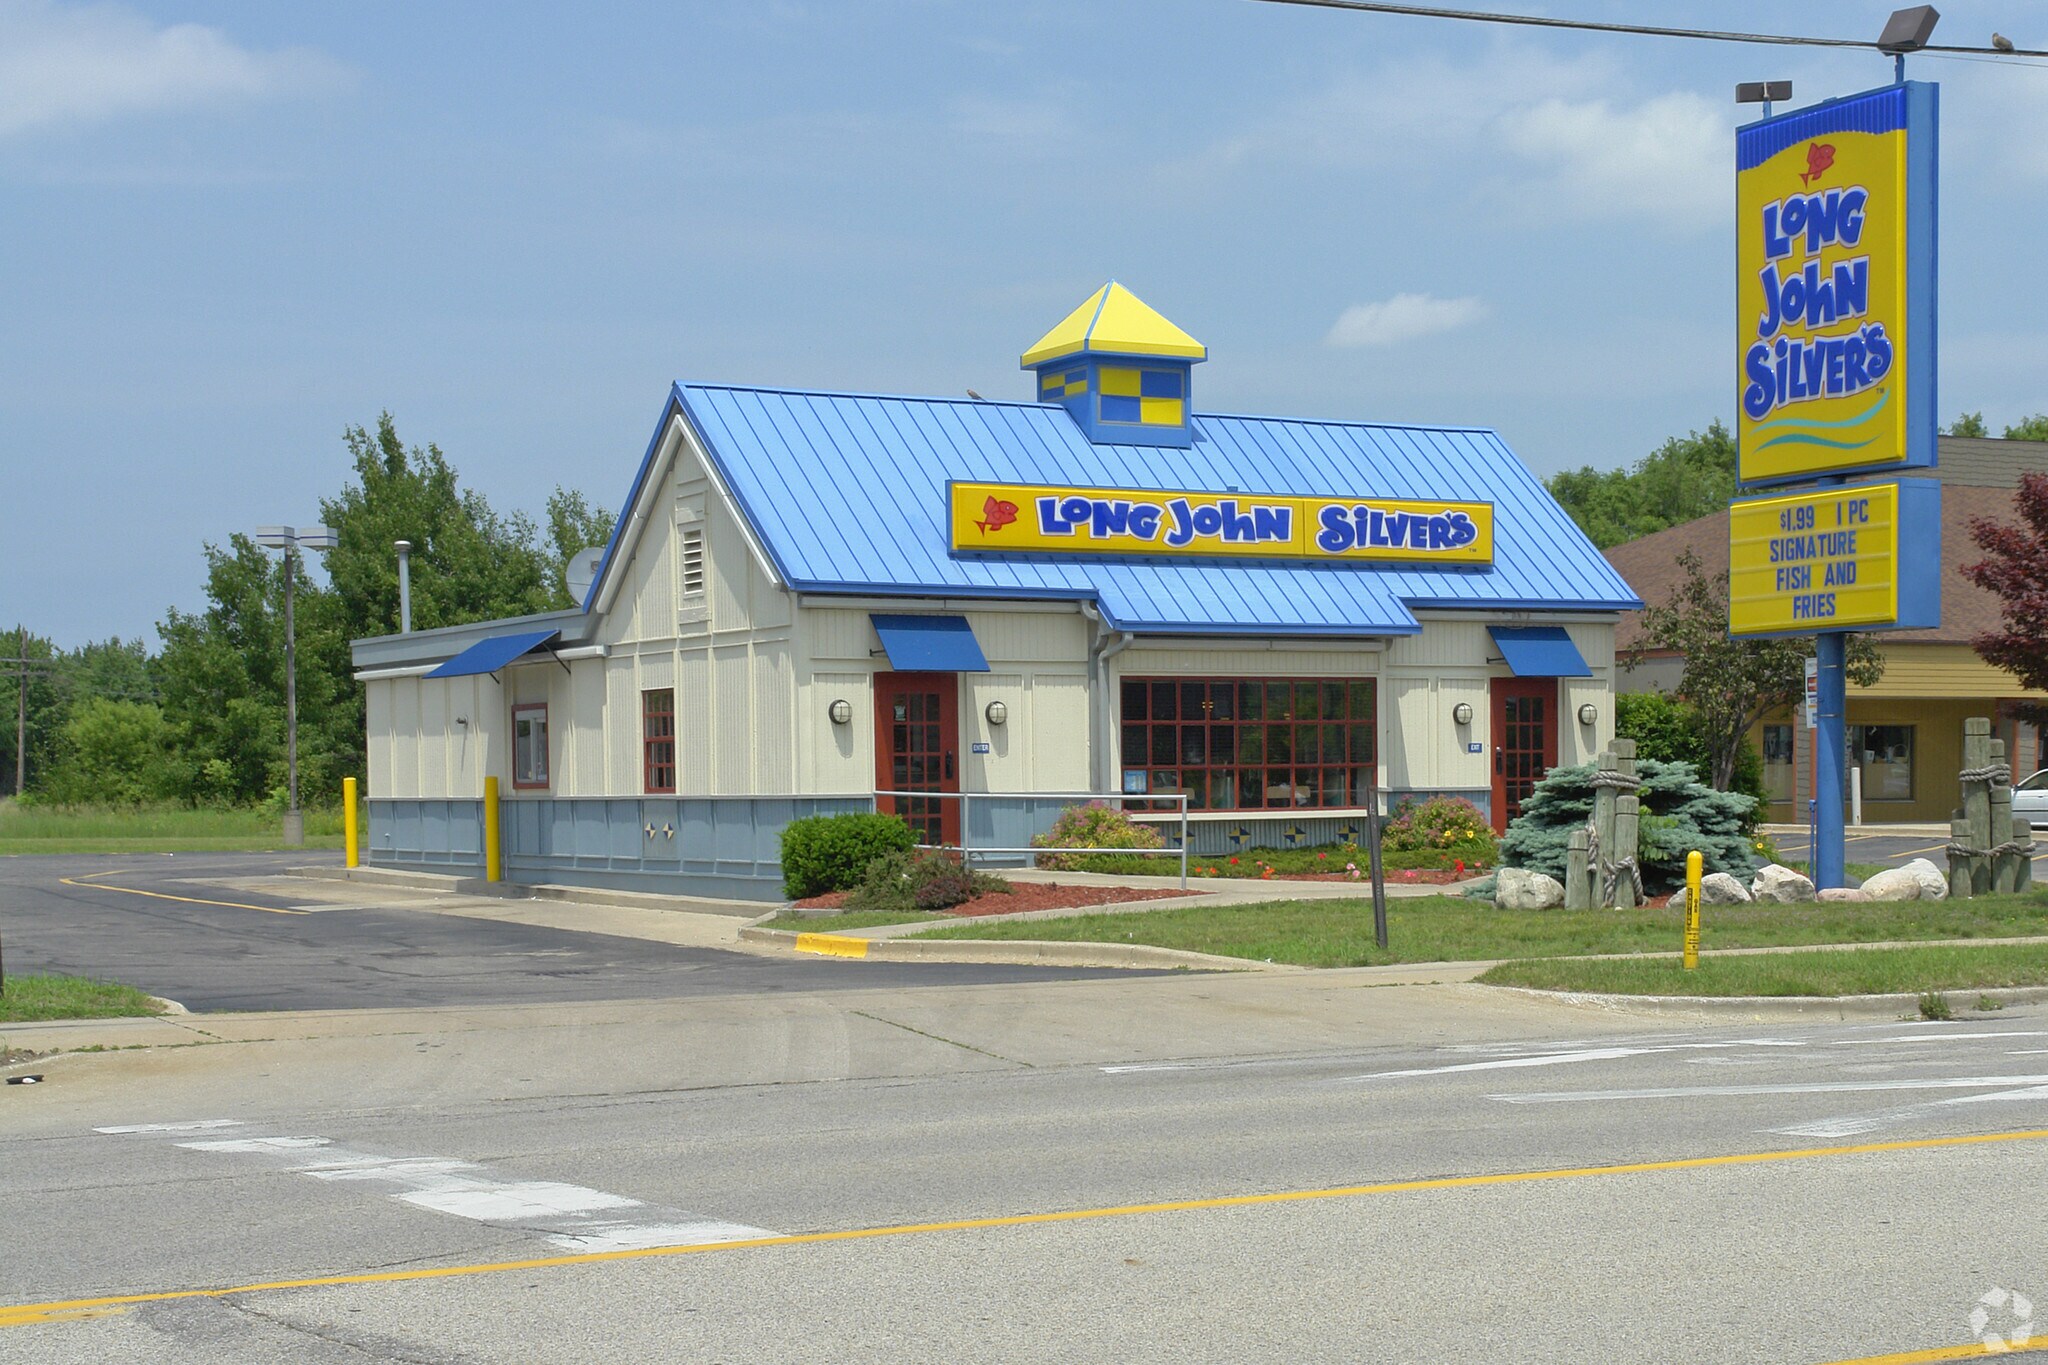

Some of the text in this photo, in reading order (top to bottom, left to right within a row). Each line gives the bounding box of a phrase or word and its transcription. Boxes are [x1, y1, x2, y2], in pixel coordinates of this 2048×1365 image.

[1780, 505, 1814, 531] $1.99
[1848, 499, 1869, 524] PC
[1769, 530, 1857, 562] SIGNATURE
[1776, 561, 1857, 591] FISH AND
[1793, 593, 1836, 619] FRIES
